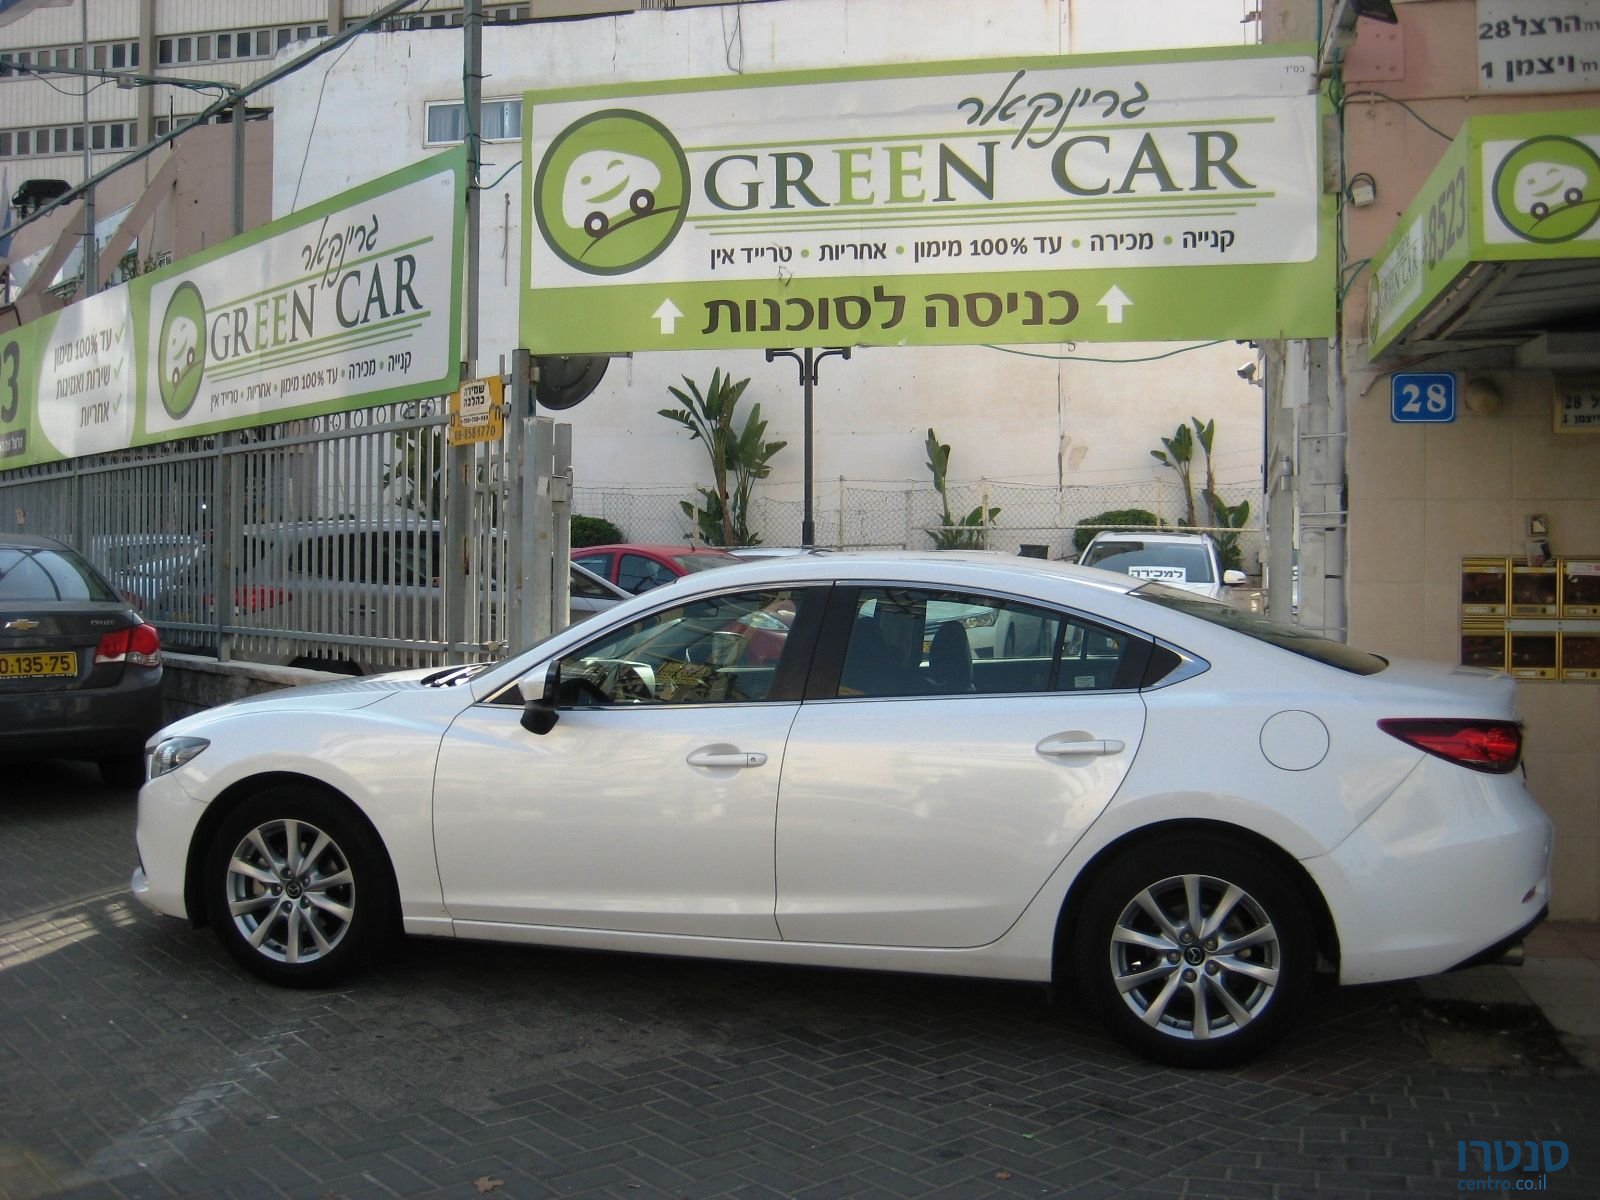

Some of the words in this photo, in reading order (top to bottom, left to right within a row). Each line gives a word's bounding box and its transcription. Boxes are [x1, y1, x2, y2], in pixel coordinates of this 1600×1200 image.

[1481, 62, 1493, 78] 1
[1506, 55, 1574, 82] ויצמן
[957, 69, 1149, 151] גרינקאר
[703, 141, 1000, 210] GREEN
[1051, 130, 1257, 196] CAR
[301, 214, 378, 290] גרינקאר
[818, 242, 887, 262] אחריות
[914, 239, 962, 263] מימון
[969, 237, 1028, 256] 100%
[1033, 236, 1062, 255] עד
[1090, 232, 1153, 252] מכירה
[1182, 229, 1235, 253] קנייה
[710, 248, 735, 270] אין
[740, 246, 793, 264] טרייד
[211, 283, 317, 361] GREEN
[335, 254, 423, 328] CAR
[701, 285, 906, 335] לסוכנות
[924, 290, 1079, 327] כניסה
[75, 333, 98, 360] 100%
[100, 328, 112, 351] עד
[54, 342, 73, 372] מימון
[388, 351, 411, 374] קנייה
[86, 364, 111, 391] שירות
[301, 371, 324, 390] 100%
[327, 367, 338, 385] עד
[348, 359, 376, 380] מכירה
[56, 373, 84, 400] ואמינות
[221, 389, 239, 406] טרייד
[246, 381, 272, 401] אחריות
[280, 375, 300, 398] מימון
[464, 385, 485, 396] שמירה
[1402, 384, 1447, 414] 28
[80, 401, 110, 427] אחריות
[1131, 569, 1183, 579] למכירה
